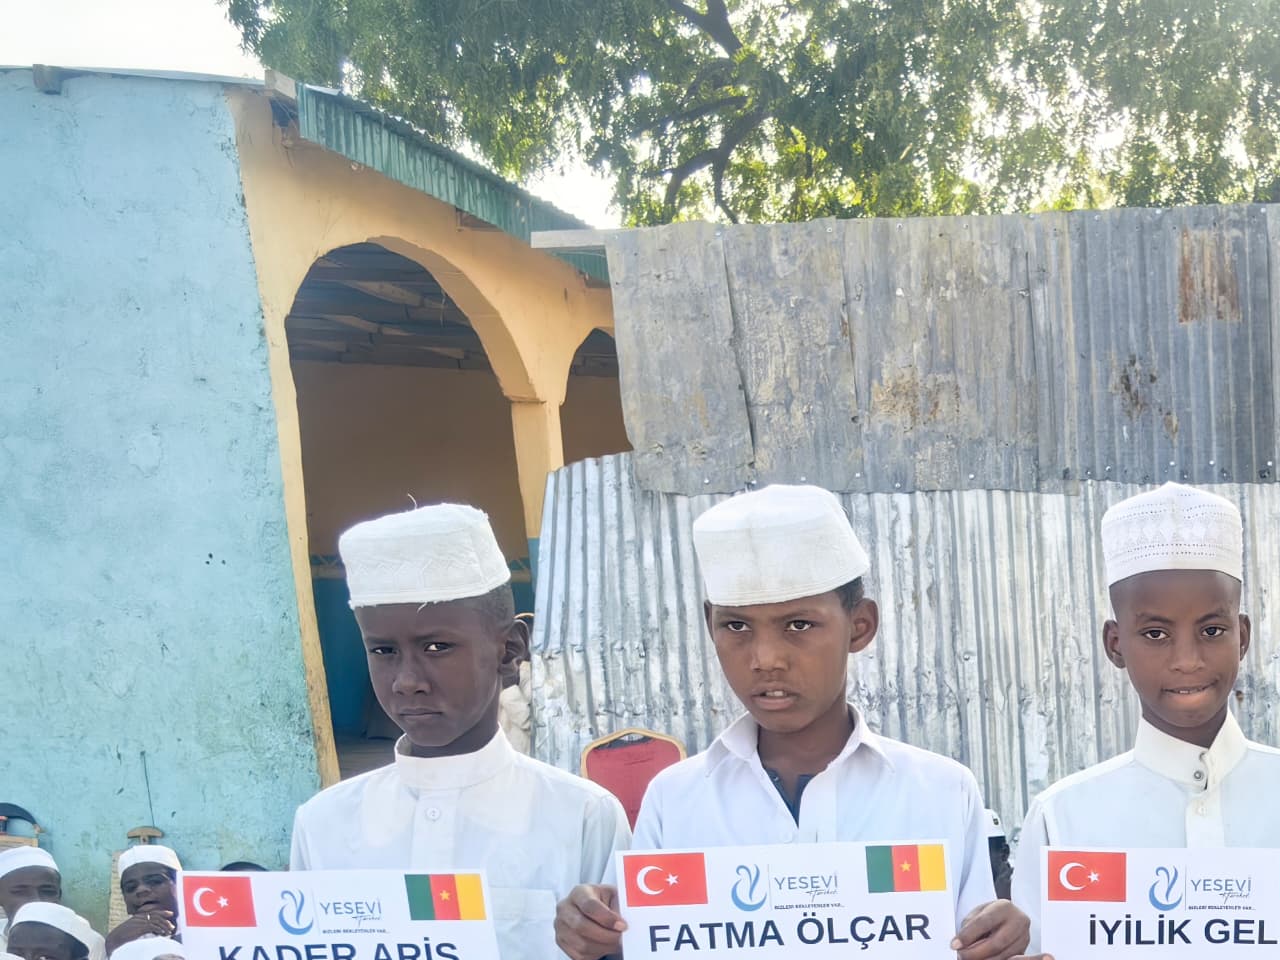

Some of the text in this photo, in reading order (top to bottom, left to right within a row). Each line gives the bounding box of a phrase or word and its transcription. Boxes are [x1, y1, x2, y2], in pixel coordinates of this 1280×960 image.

[649, 912, 931, 952] FATMA ÖLÇAR
[1090, 914, 1192, 945] İYİLİK
